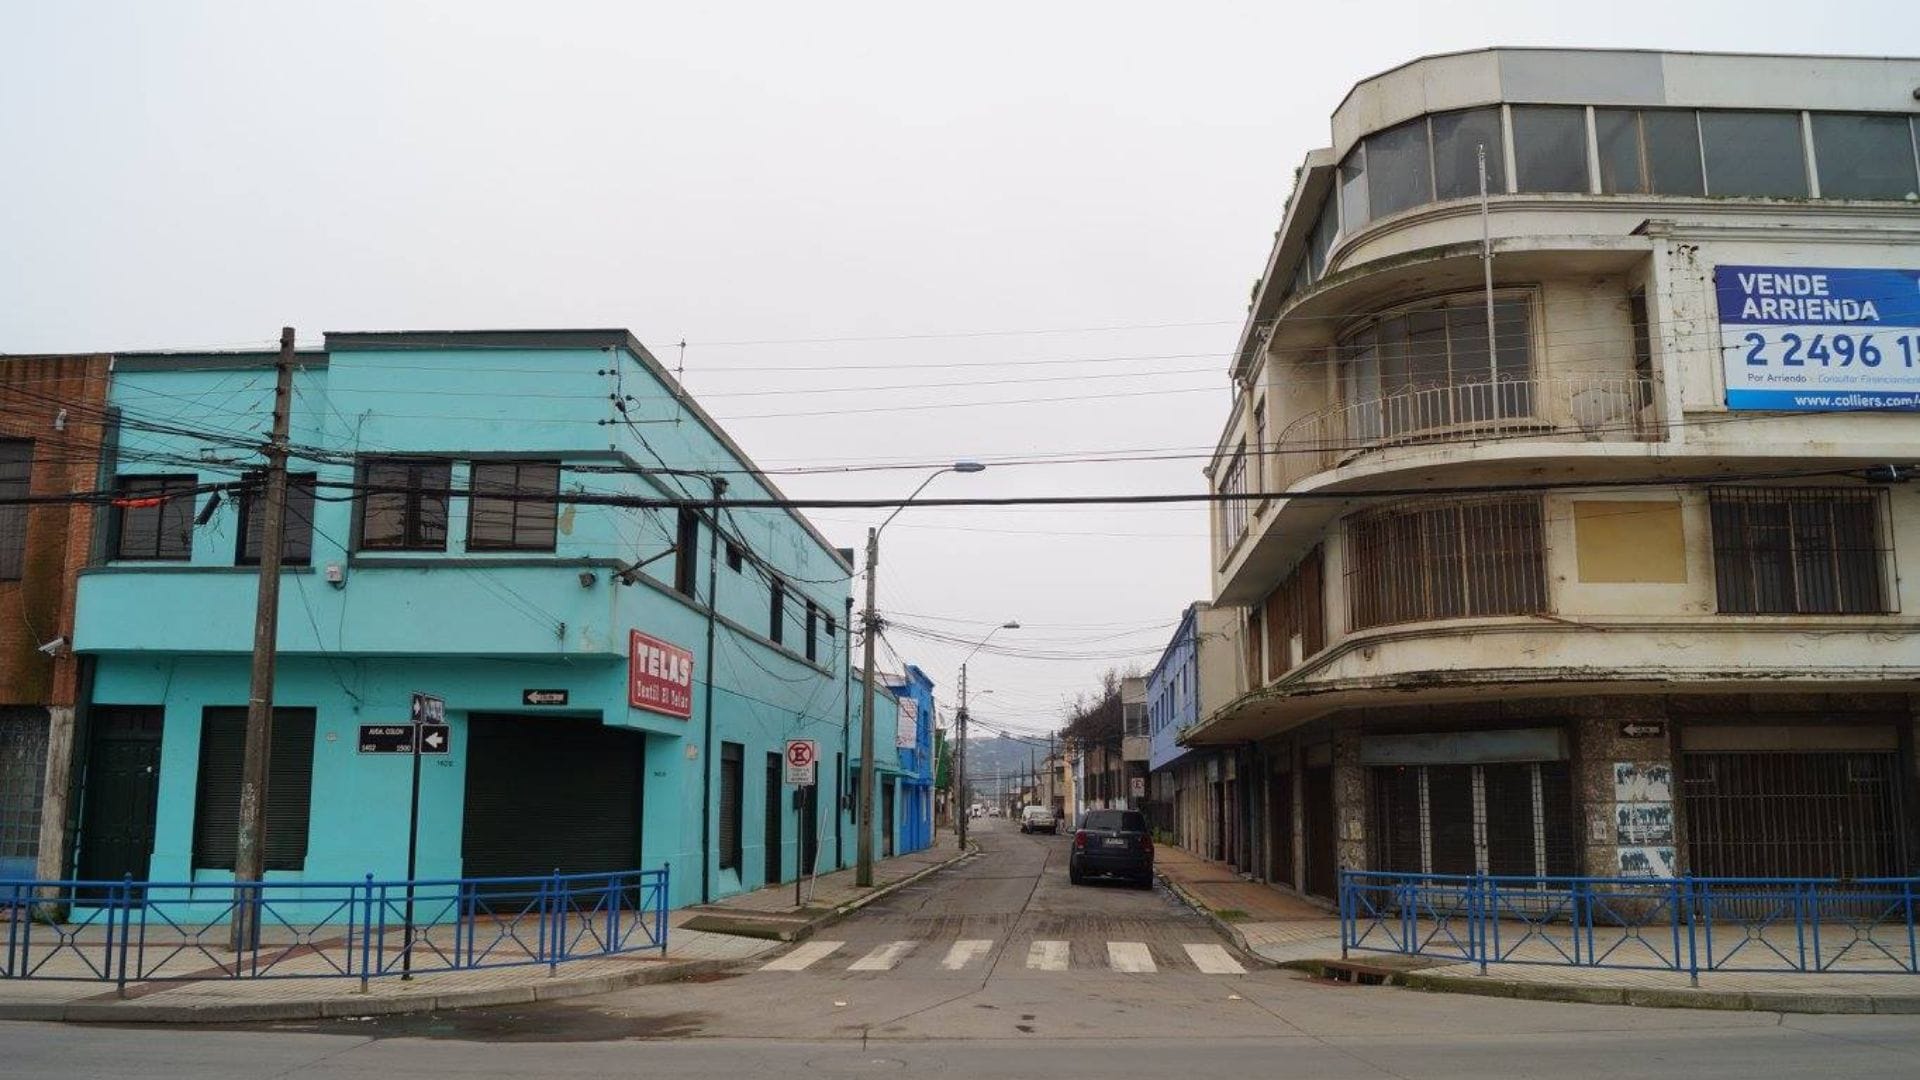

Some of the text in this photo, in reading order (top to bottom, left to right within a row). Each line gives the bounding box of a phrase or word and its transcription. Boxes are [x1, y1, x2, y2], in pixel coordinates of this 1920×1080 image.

[1737, 272, 1830, 296] VENDE
[1741, 297, 1880, 321] ARRIENDA
[1744, 332, 1768, 366] 2
[1781, 332, 1882, 367] 2496
[1748, 373, 1764, 383] Por
[1767, 373, 1807, 383] Arriendo
[637, 642, 690, 687] TELAS
[637, 680, 660, 701] Textil
